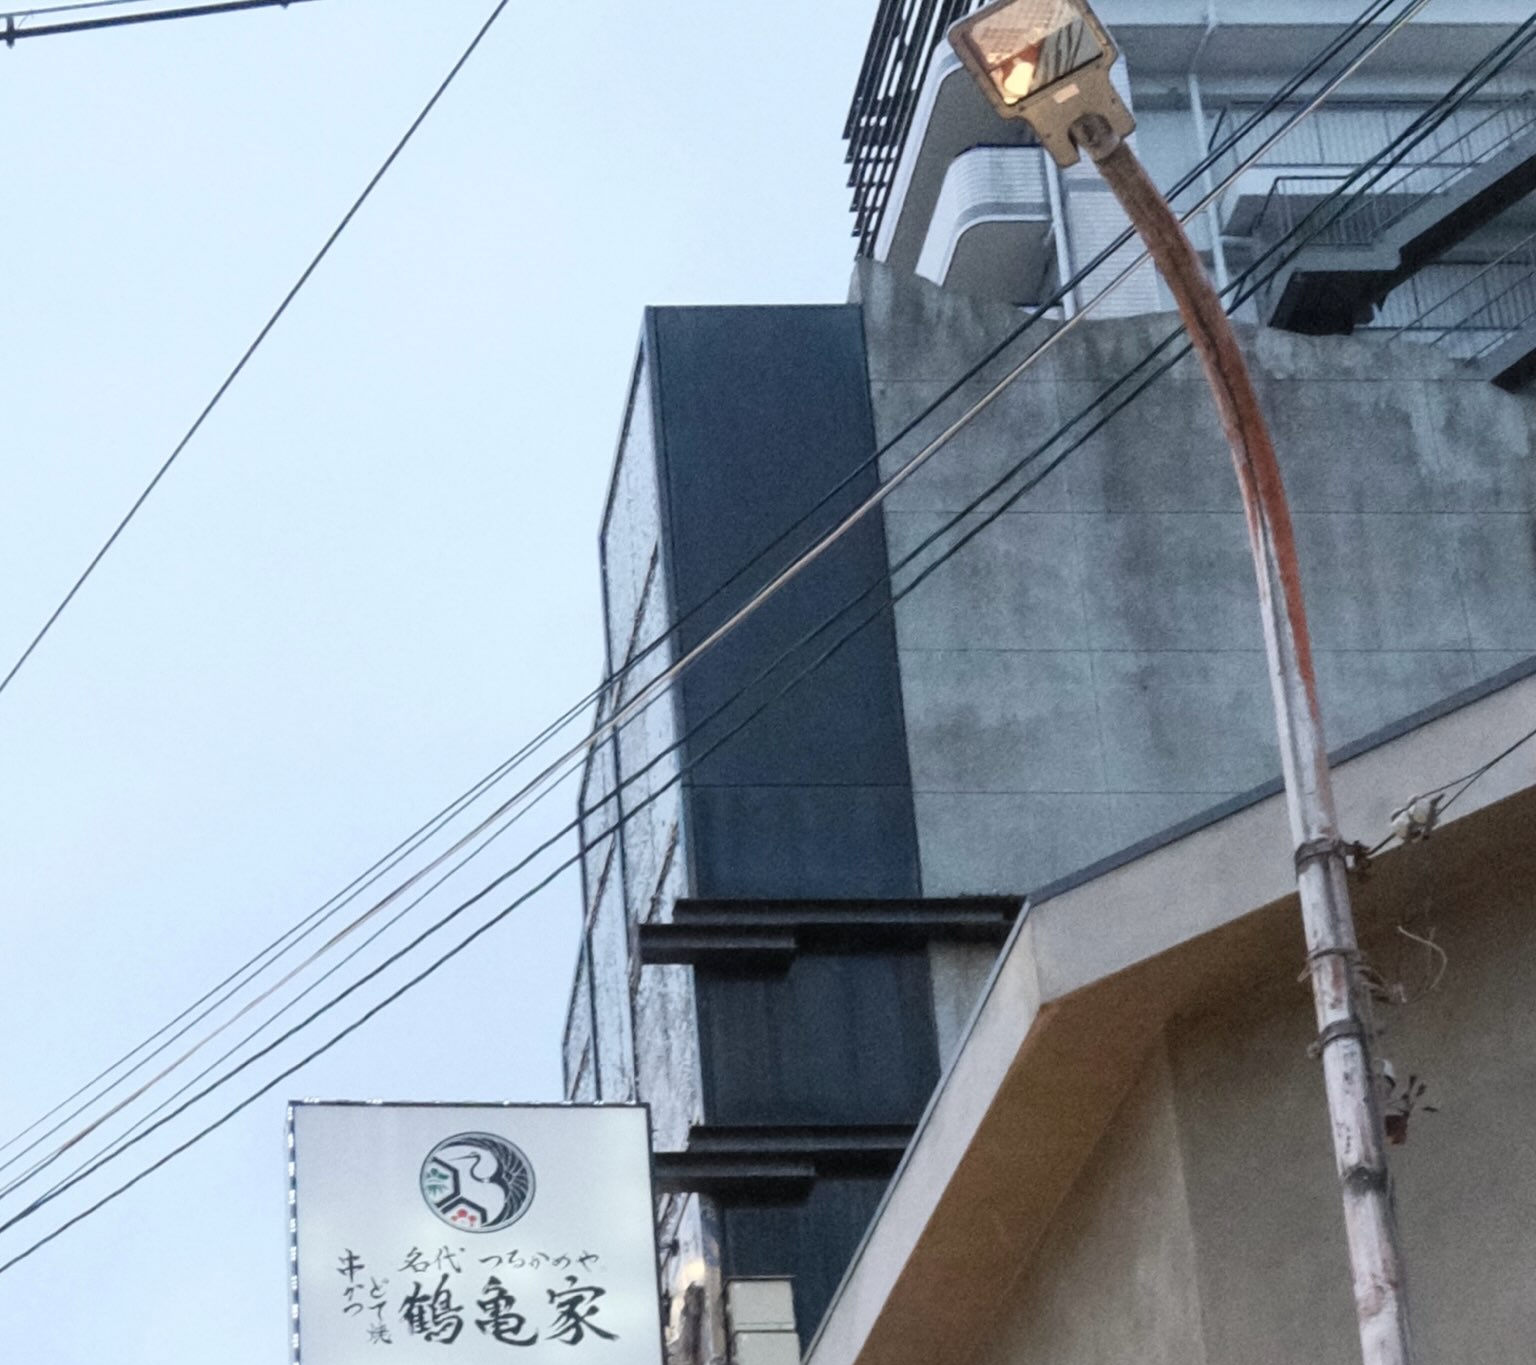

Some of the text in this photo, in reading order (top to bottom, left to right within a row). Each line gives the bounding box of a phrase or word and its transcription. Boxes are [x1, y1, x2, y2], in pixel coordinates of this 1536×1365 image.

[398, 1246, 465, 1274] 名代
[398, 1274, 619, 1346] 鶴亀家
